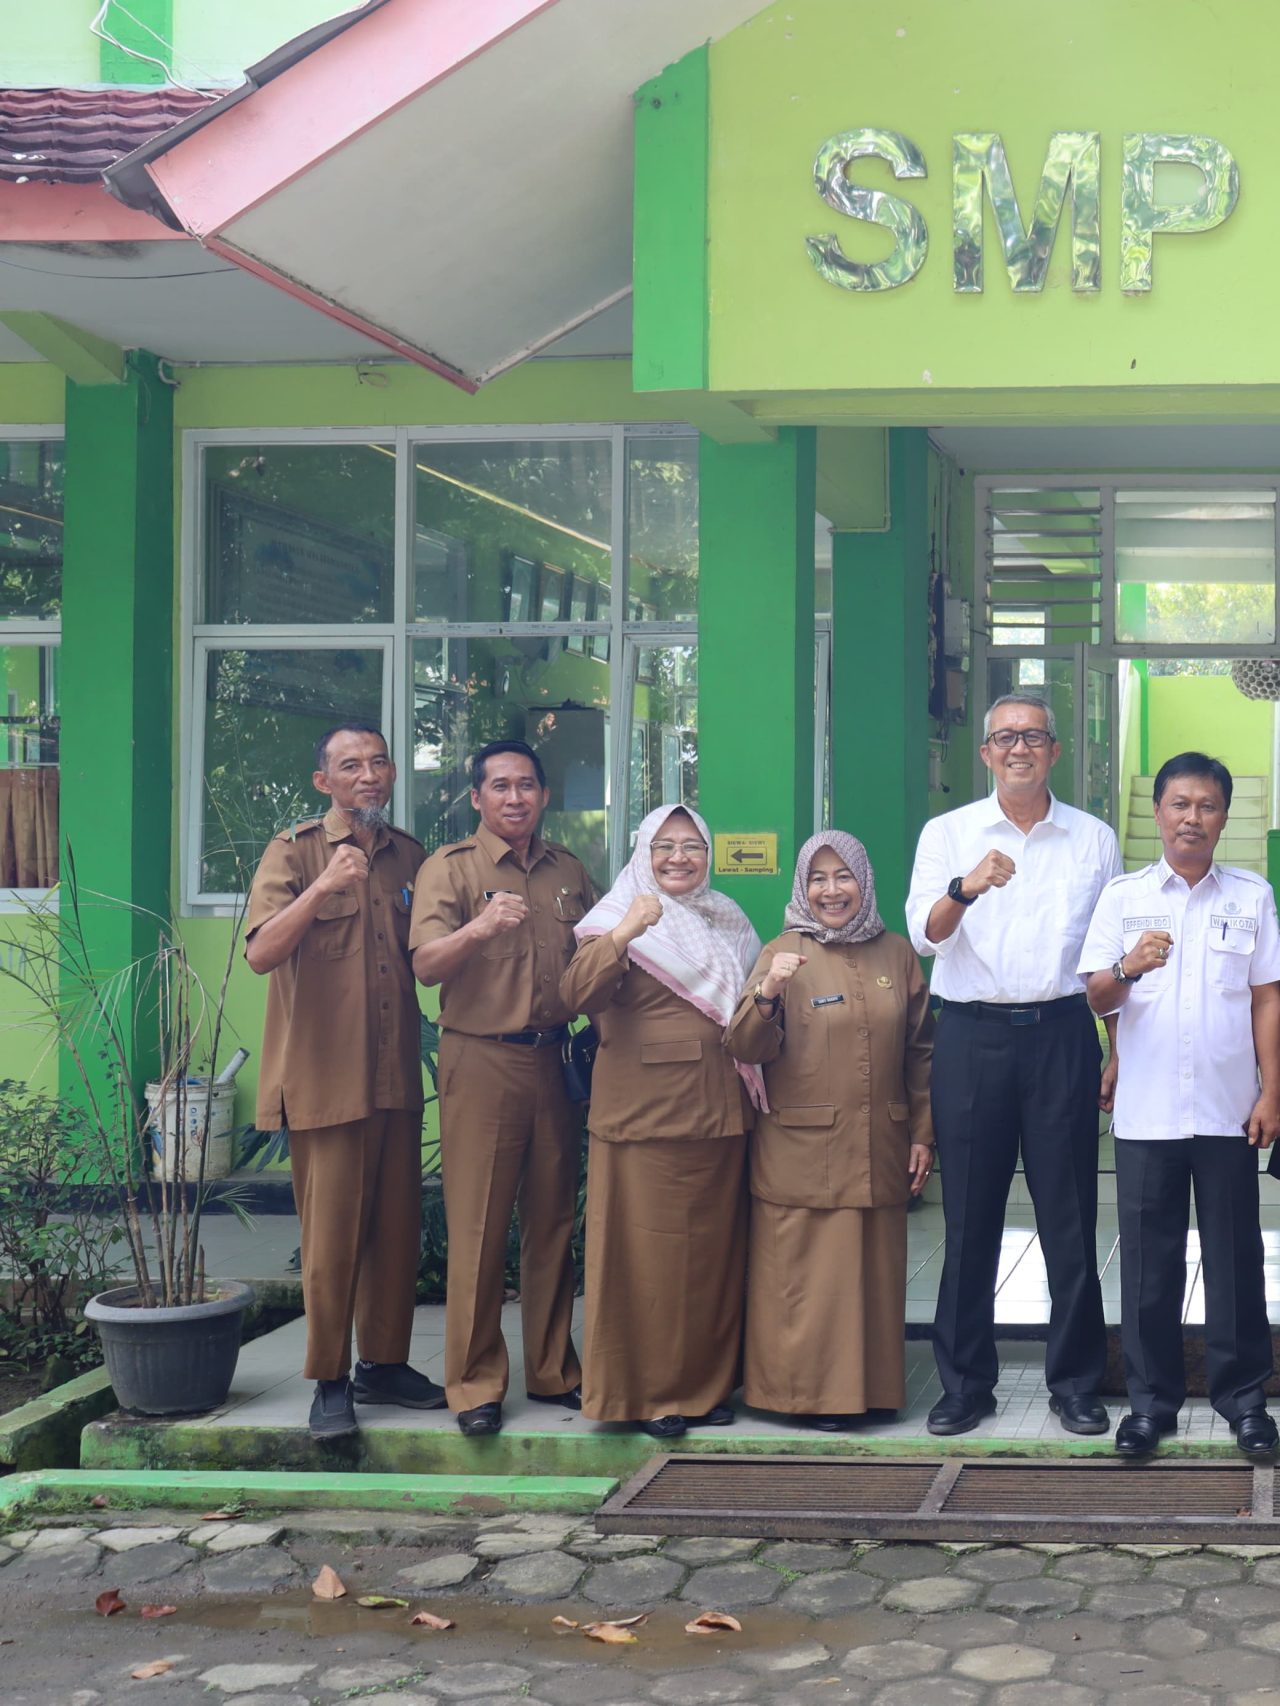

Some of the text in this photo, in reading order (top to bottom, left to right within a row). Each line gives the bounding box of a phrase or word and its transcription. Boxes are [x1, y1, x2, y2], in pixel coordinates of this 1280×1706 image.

[805, 127, 1240, 293] SMP
[1154, 918, 1168, 927] EDO
[1212, 917, 1254, 930] WALIKOTA
